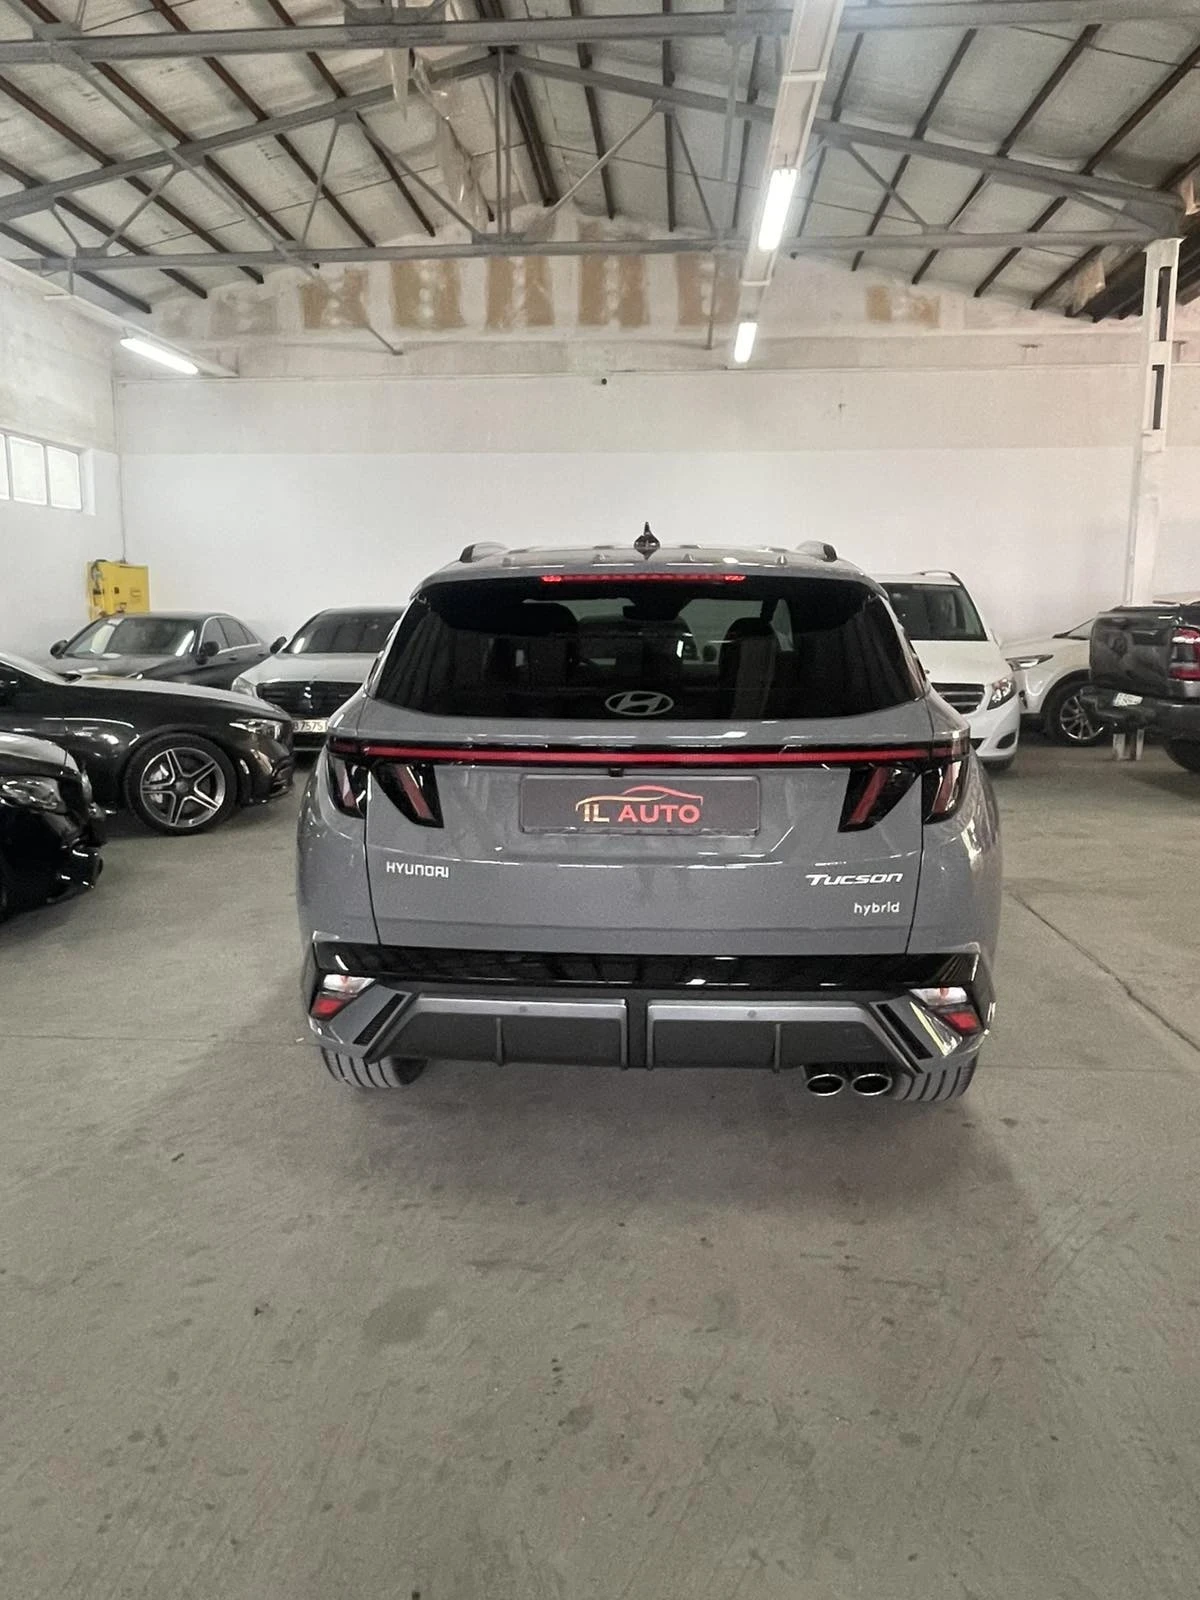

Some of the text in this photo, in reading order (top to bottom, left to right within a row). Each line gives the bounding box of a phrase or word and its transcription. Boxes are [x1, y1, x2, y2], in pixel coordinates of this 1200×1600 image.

[583, 803, 701, 824] IL AUTO
[386, 861, 449, 879] HYUNDAI
[853, 901, 900, 916] hybrid
